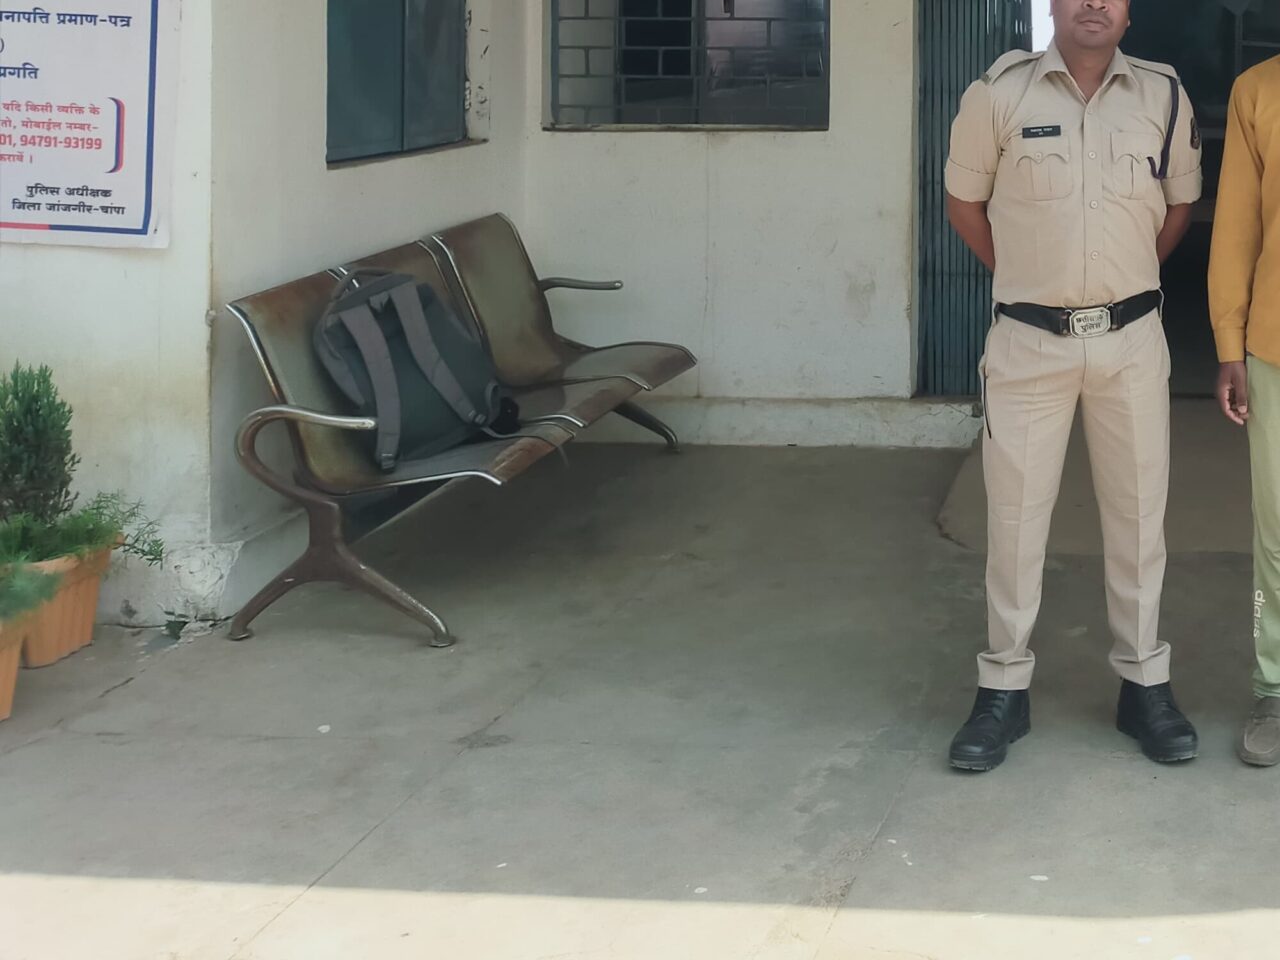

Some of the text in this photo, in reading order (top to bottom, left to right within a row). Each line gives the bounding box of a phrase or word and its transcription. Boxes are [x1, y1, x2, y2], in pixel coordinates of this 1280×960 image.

[20, 135, 102, 150] 94791-93199
[26, 182, 60, 198] पुलिस
[12, 198, 41, 211] जिला
